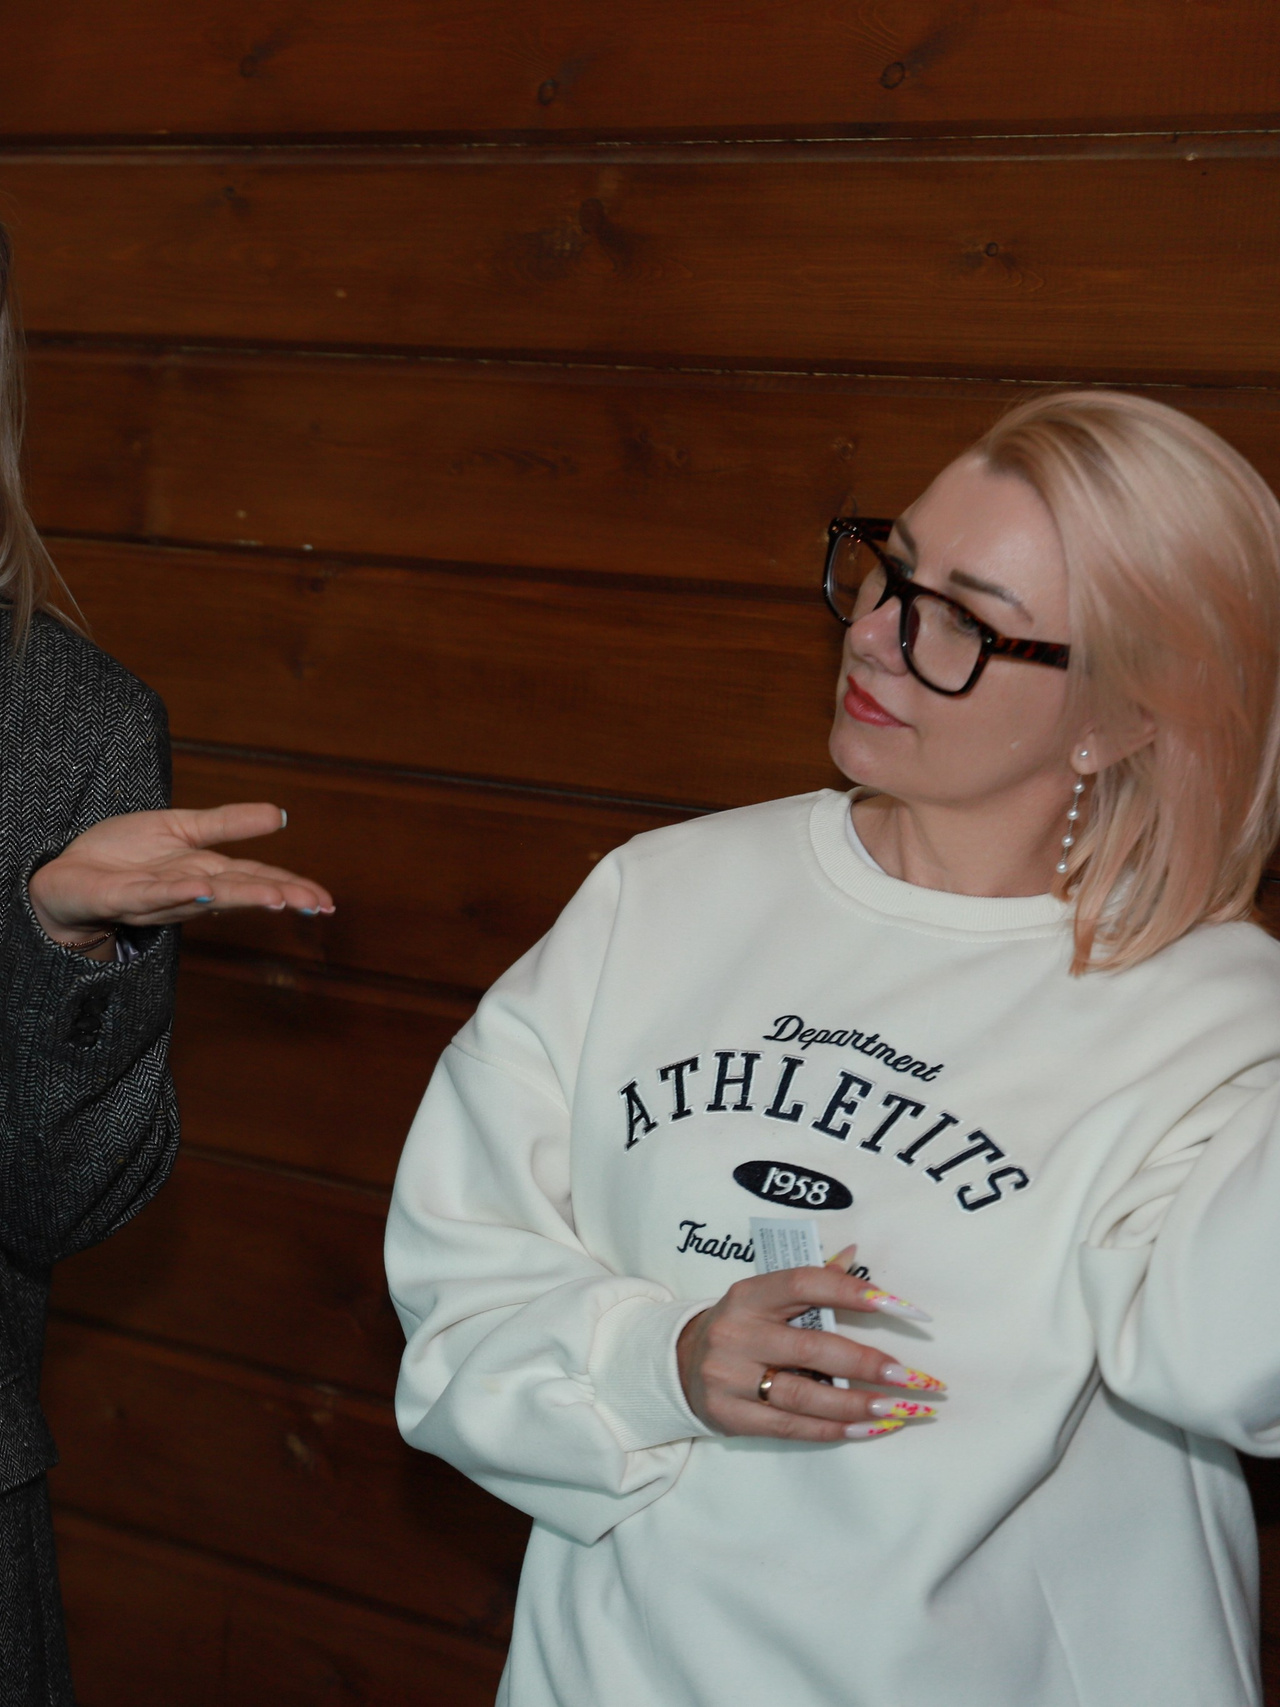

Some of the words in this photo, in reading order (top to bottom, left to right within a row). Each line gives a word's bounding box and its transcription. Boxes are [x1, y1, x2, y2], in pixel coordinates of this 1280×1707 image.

[763, 1015, 945, 1082] Department
[619, 1049, 1031, 1214] ATHLETITS
[761, 1166, 830, 1206] 1958
[676, 1219, 756, 1262] Traini
